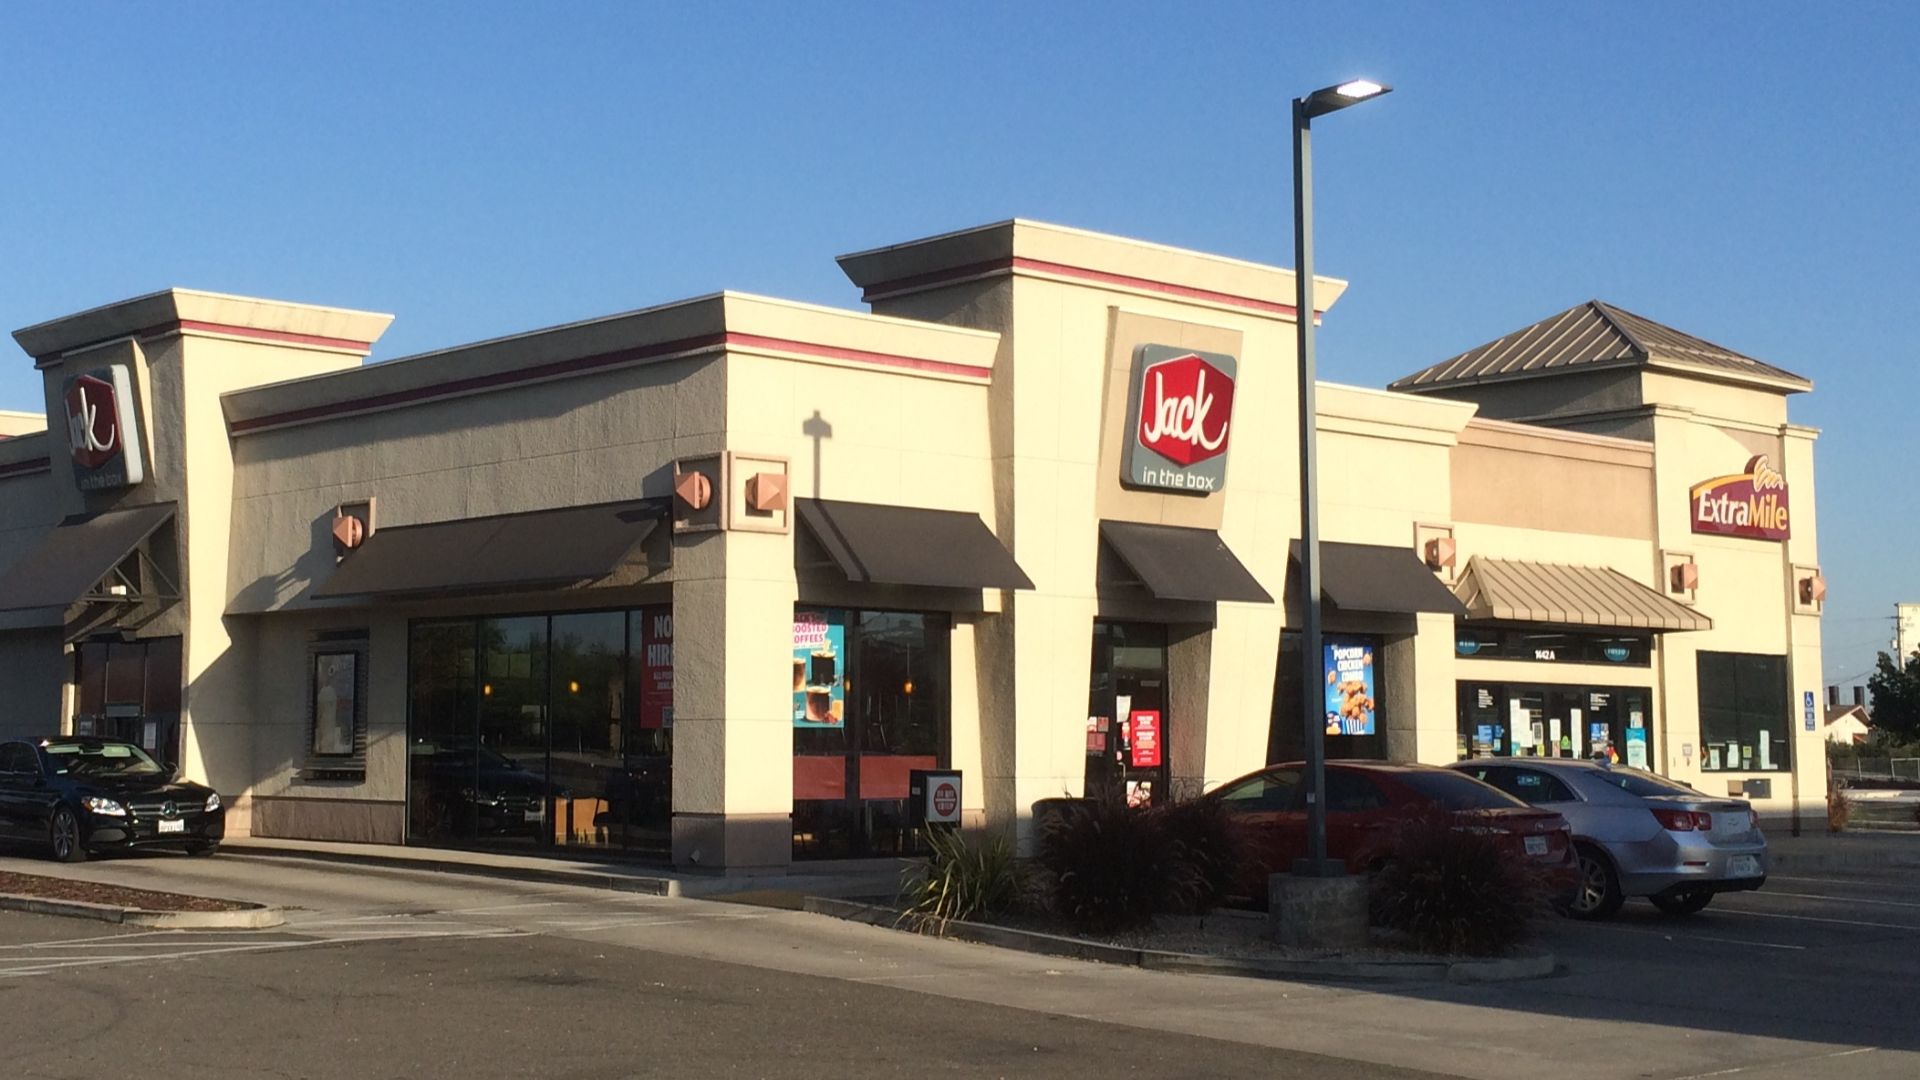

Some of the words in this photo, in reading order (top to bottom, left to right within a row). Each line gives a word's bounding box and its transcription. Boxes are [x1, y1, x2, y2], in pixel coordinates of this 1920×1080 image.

[1144, 368, 1228, 451] Jack
[1142, 466, 1157, 484] in
[1159, 468, 1184, 487] the
[1187, 471, 1216, 490] box
[1697, 489, 1788, 531] ExtraMile
[654, 615, 673, 639] NO
[793, 623, 827, 634] OOSTED
[793, 633, 824, 644] OFFEES
[1334, 647, 1363, 660] POPCORN
[1337, 659, 1364, 671] CHICKEN
